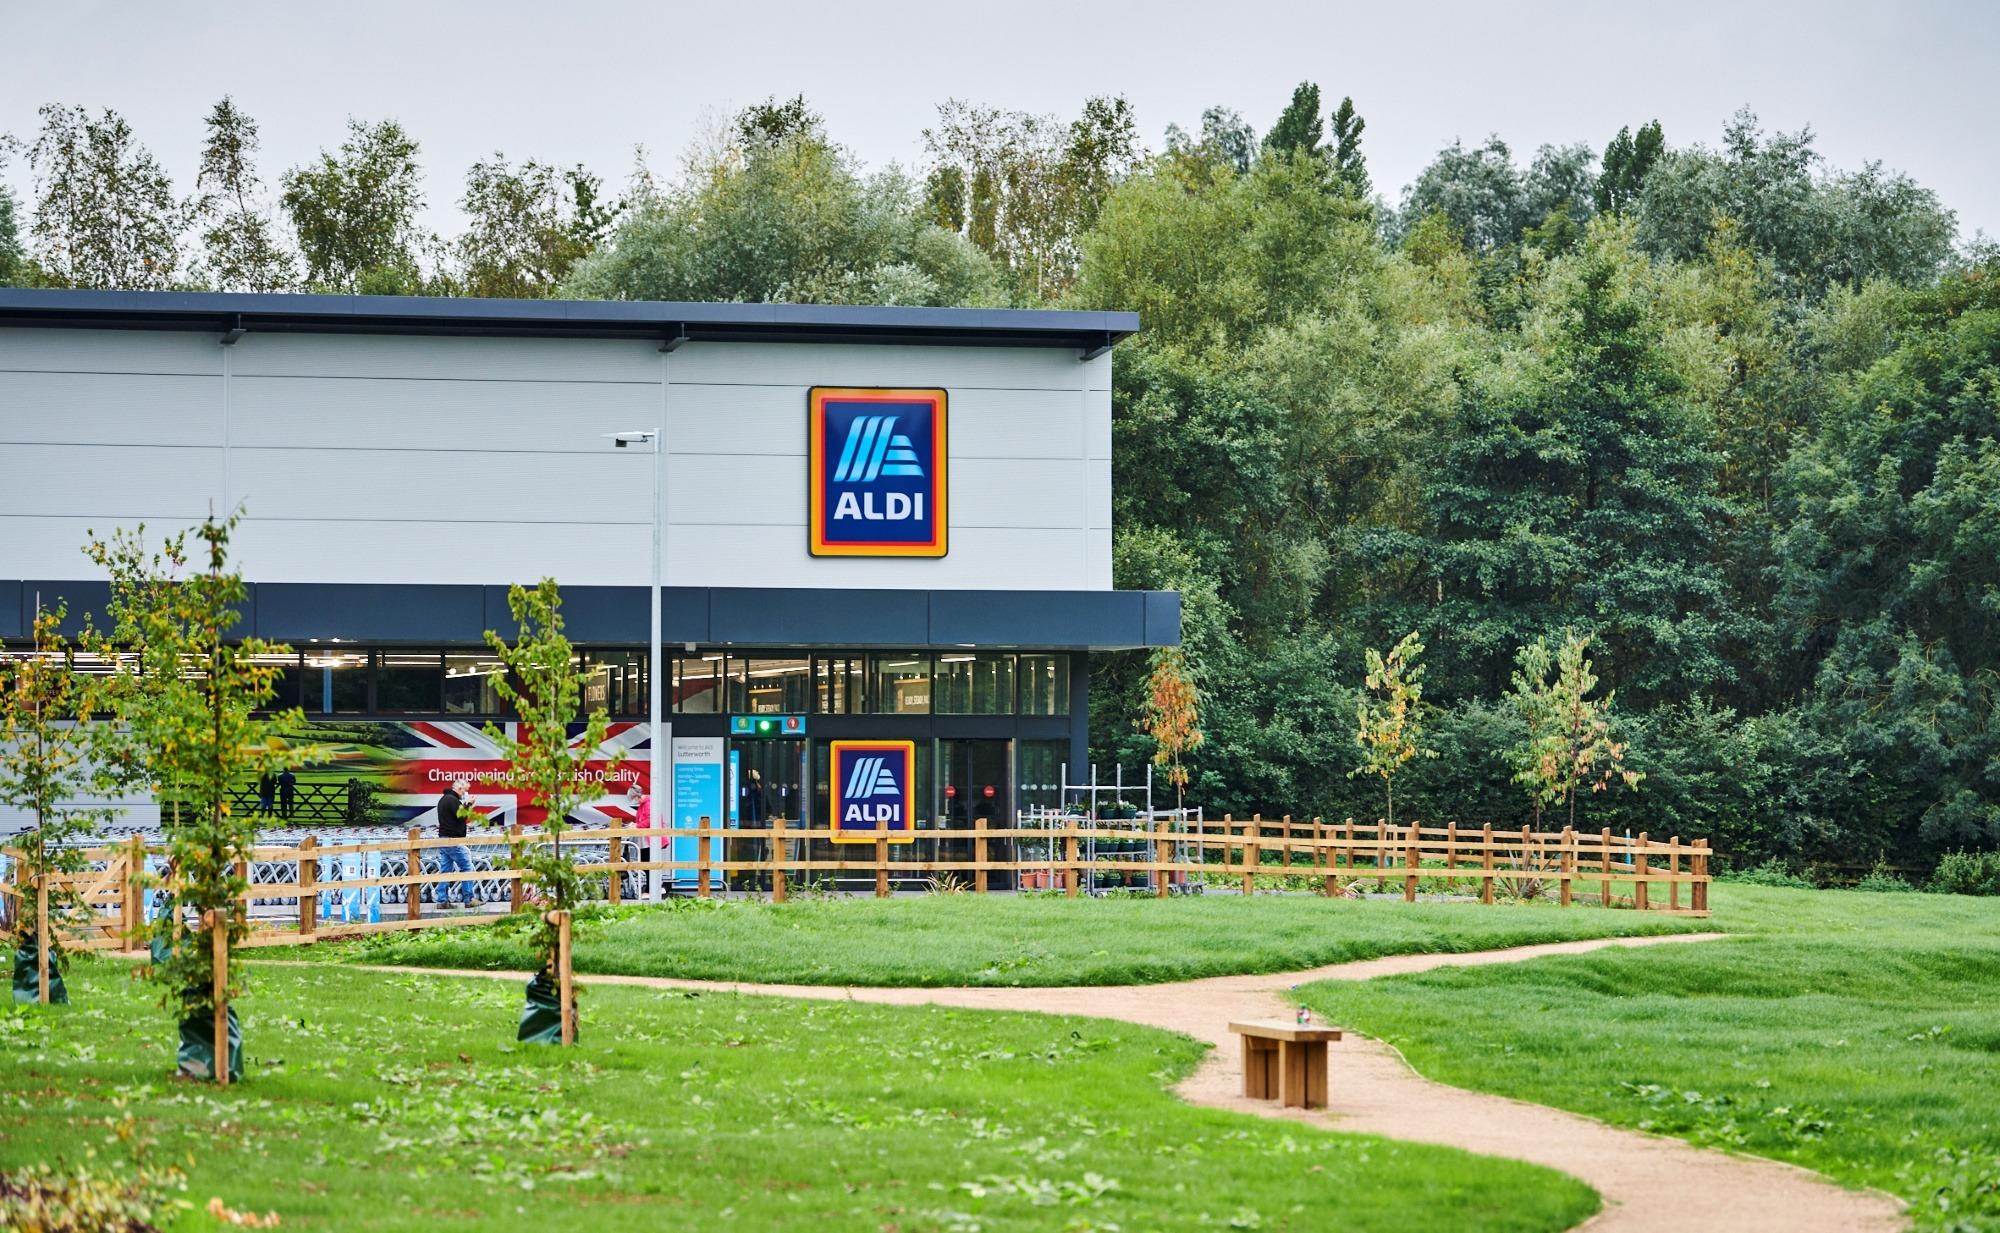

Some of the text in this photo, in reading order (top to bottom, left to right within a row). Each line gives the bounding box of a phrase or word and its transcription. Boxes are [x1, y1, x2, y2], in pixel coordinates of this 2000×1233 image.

[833, 492, 923, 520] ALDI
[428, 767, 514, 783] Championing
[595, 768, 640, 785] Quality
[844, 804, 900, 821] ALDI
